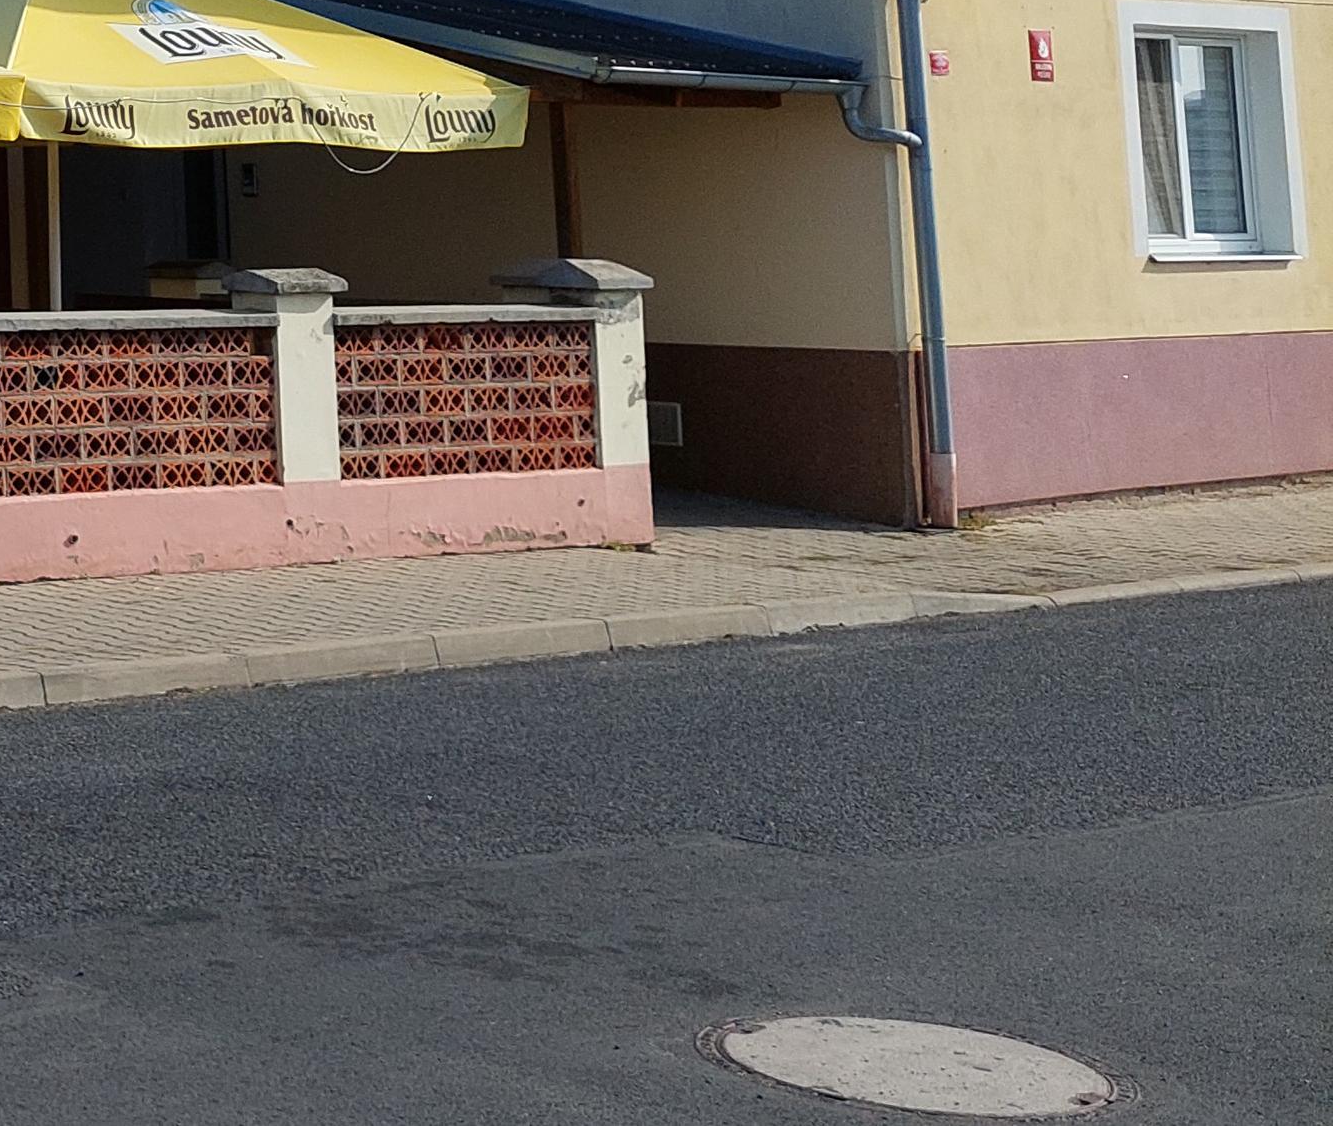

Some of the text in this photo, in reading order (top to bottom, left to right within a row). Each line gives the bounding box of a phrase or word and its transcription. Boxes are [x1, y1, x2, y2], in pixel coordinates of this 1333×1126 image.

[138, 27, 285, 60] Louny
[60, 94, 135, 140] Louny
[301, 103, 377, 132] hořkost
[425, 105, 496, 144] Louny
